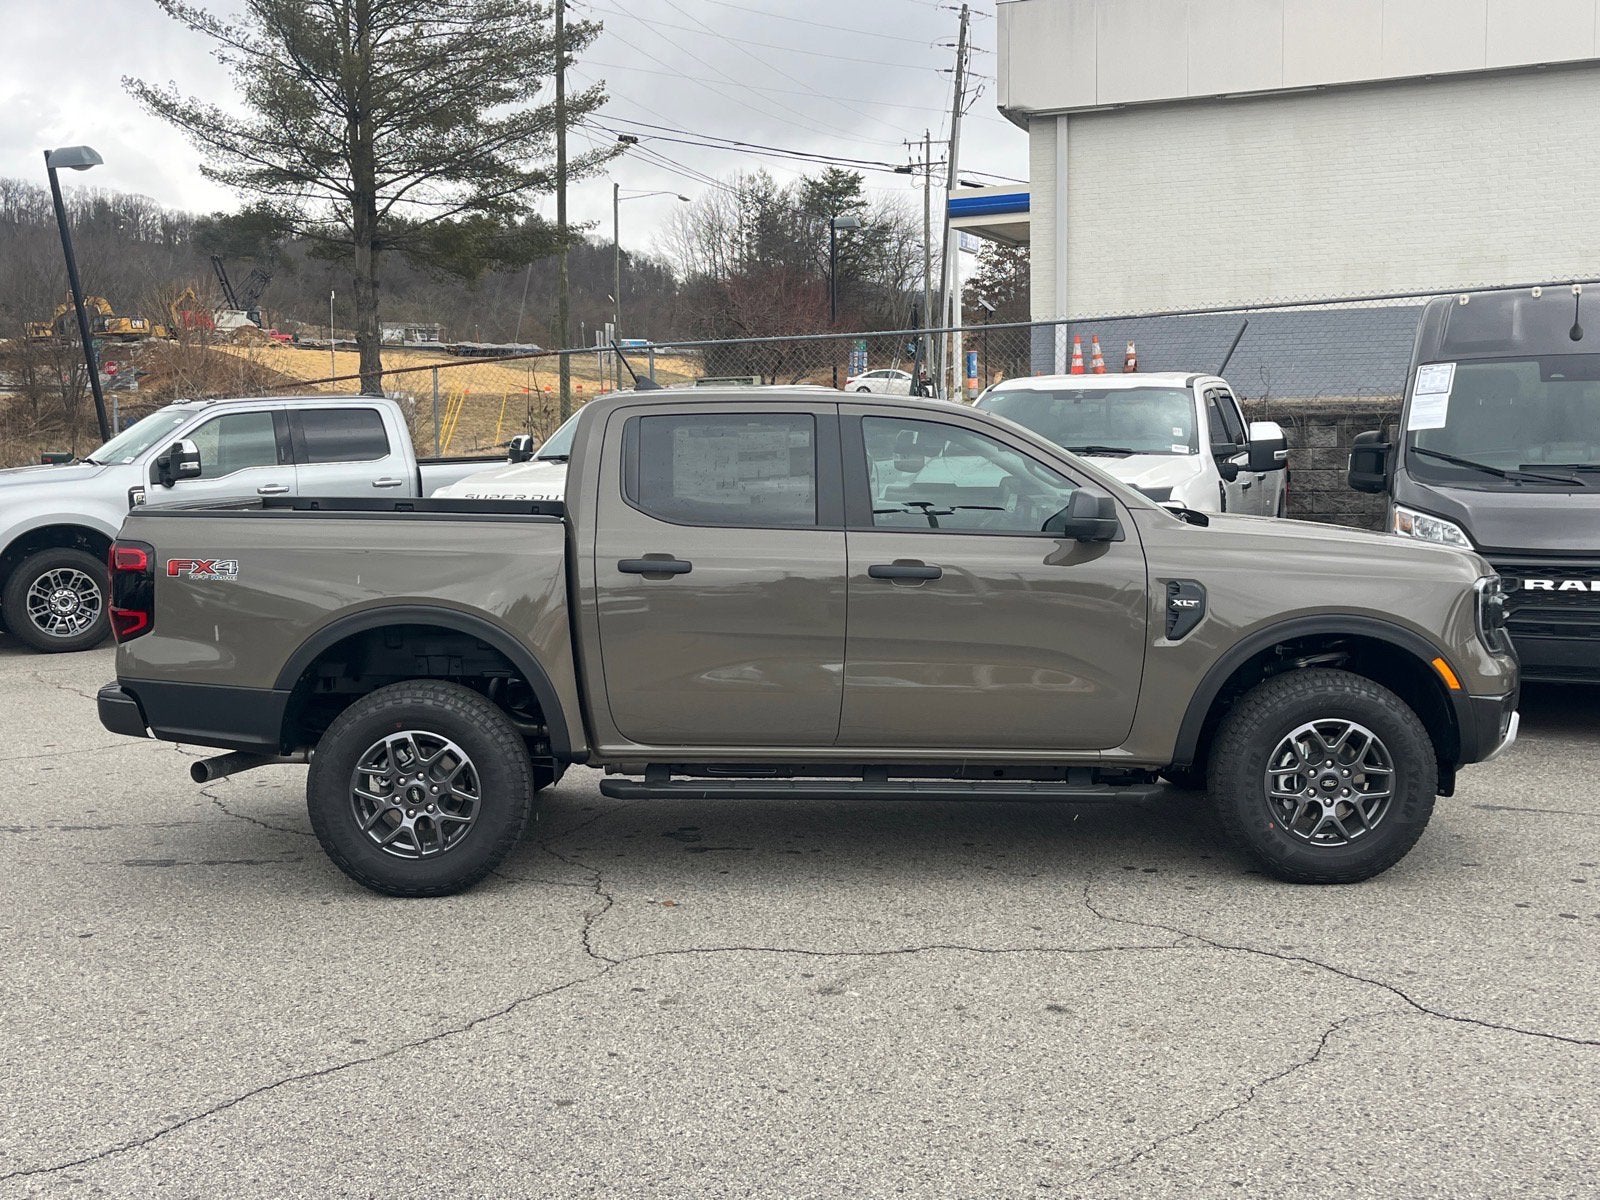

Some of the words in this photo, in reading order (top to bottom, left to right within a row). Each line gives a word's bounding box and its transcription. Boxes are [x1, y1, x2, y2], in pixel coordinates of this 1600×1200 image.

[131, 319, 144, 329] CAT
[167, 559, 238, 577] FX4
[1524, 579, 1600, 591] RA
[1172, 599, 1200, 607] XLT
